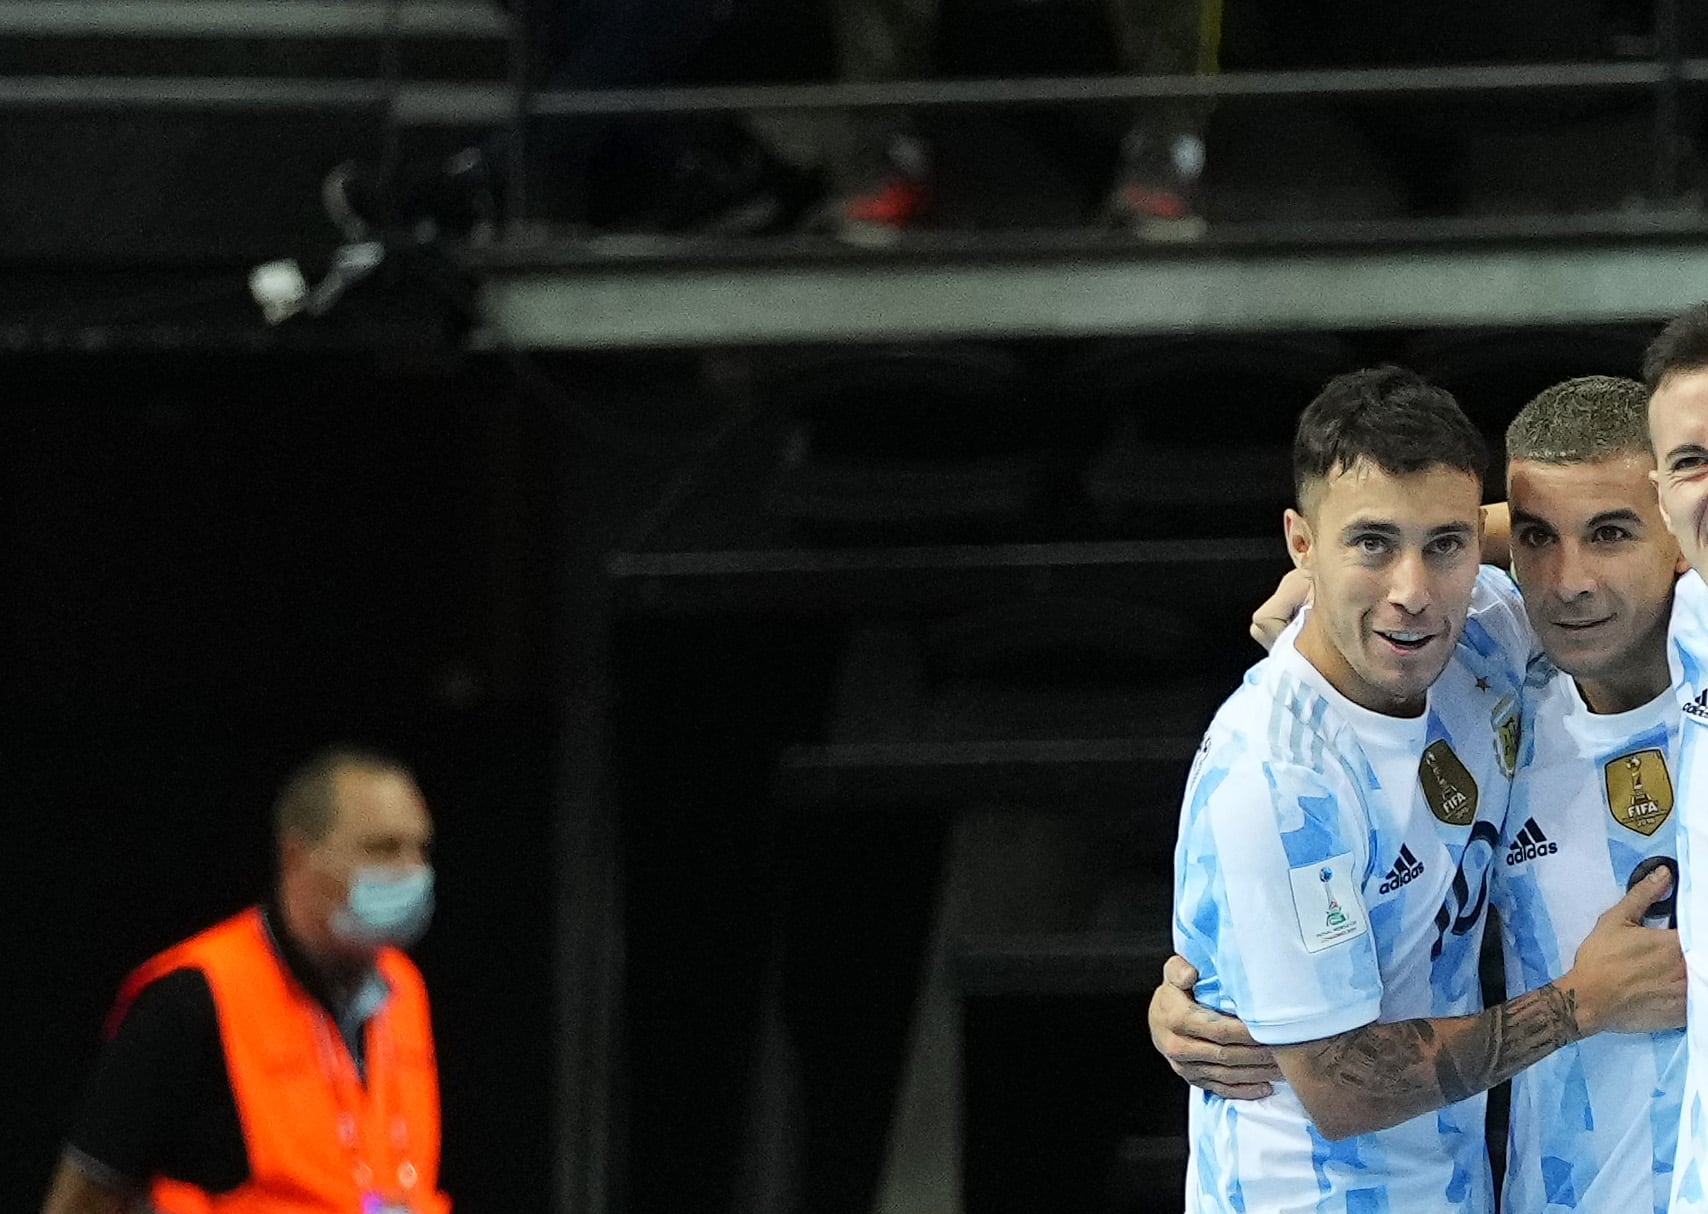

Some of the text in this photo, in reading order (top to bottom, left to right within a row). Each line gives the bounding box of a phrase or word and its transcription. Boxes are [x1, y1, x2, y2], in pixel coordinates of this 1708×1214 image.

[1442, 791, 1467, 814] FIFA
[1628, 801, 1658, 817] FIFA
[1506, 841, 1558, 866] adidas
[1379, 862, 1425, 895] adidas
